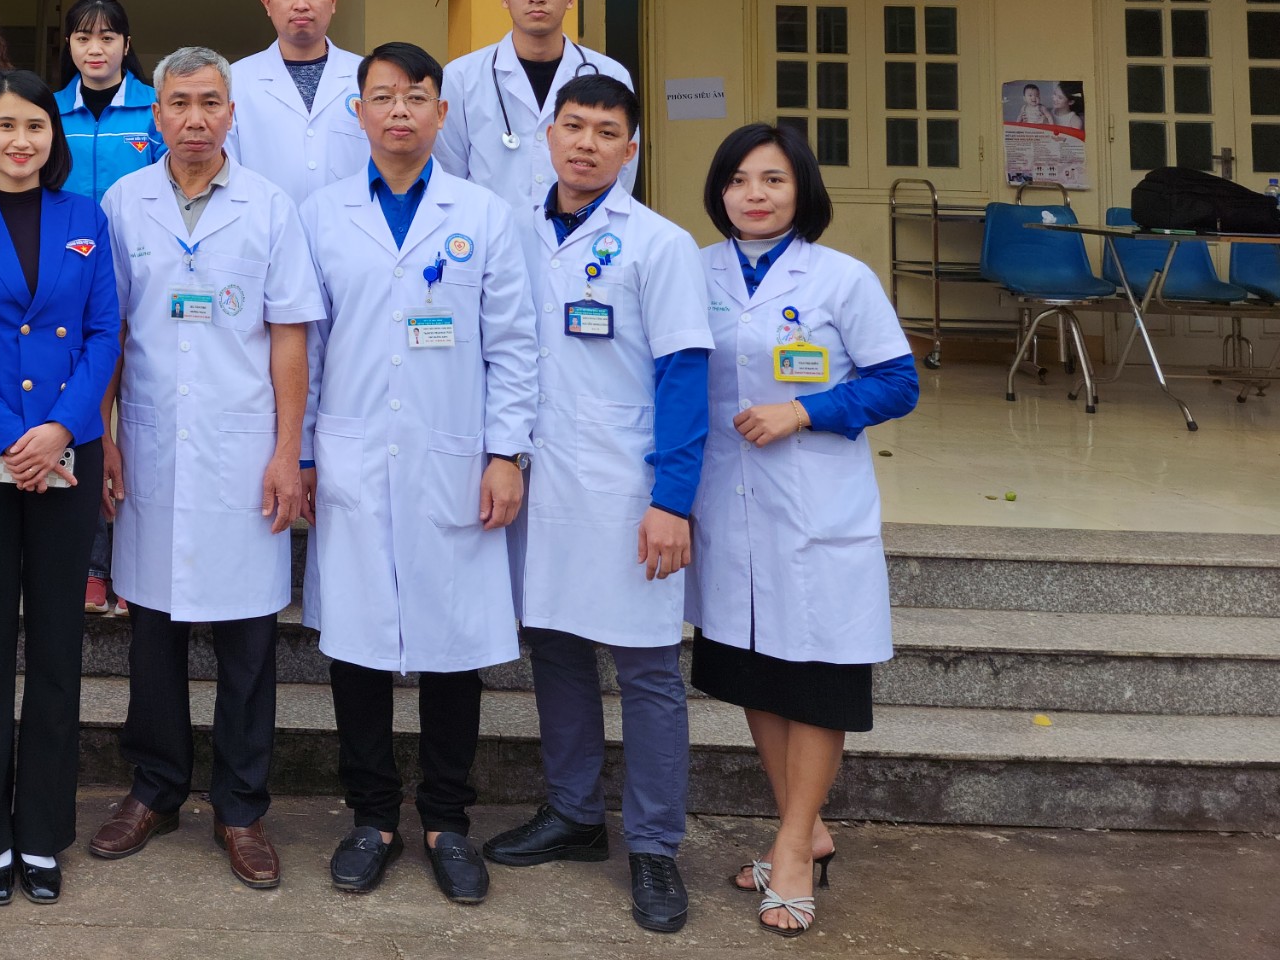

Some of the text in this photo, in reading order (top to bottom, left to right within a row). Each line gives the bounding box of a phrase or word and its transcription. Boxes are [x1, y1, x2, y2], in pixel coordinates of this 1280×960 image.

[667, 90, 725, 100] PHÒNG SIÊU ÂM
